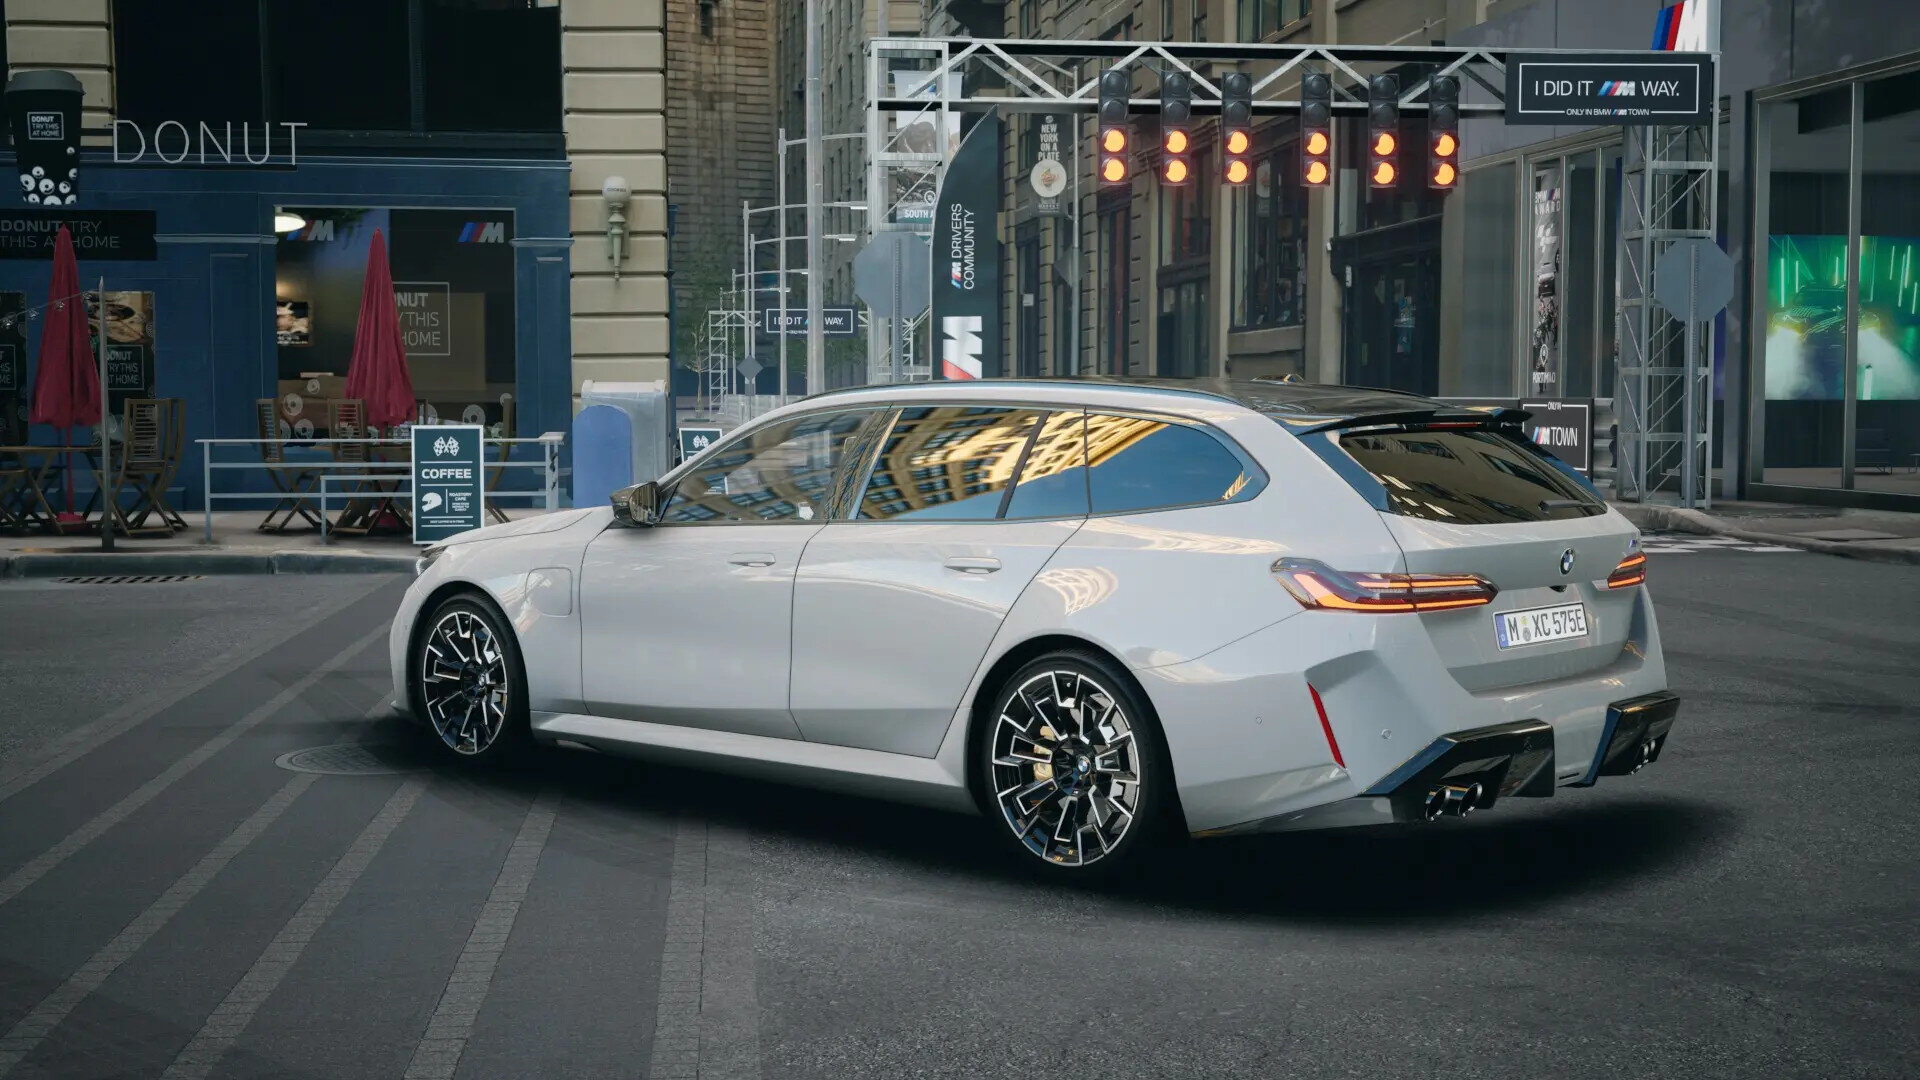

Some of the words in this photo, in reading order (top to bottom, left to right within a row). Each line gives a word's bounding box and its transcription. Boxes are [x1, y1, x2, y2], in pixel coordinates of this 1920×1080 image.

[1535, 81, 1539, 96] I
[1543, 80, 1573, 96] DID
[1577, 80, 1594, 96] IT
[1641, 80, 1680, 96] WAY.
[1566, 108, 1584, 116] ONLY
[1585, 108, 1593, 116] IN
[1593, 108, 1612, 116] BMW
[1628, 108, 1650, 116] TOWN
[1041, 124, 1058, 133] NEW
[113, 119, 308, 165] DONUT
[1040, 133, 1059, 143] YORK
[1040, 143, 1049, 152] ON
[1052, 143, 1058, 152] A
[1038, 152, 1060, 161] PLATE
[904, 209, 929, 218] SOUTH
[1, 219, 63, 233] DONUT
[66, 219, 102, 233] TRY
[951, 203, 963, 259] DRIVERS
[0, 236, 37, 248] THIS
[963, 209, 975, 290] COMMUNITY
[395, 292, 429, 307] NUT
[405, 311, 440, 327] THIS
[794, 317, 803, 325] IT
[825, 317, 844, 325] WAY.
[116, 374, 140, 384] HOME
[1551, 426, 1578, 446] TOWN
[421, 468, 472, 479] COFFEE
[1508, 617, 1520, 642] M
[1532, 613, 1551, 637] XC
[1552, 608, 1585, 635] 575E
